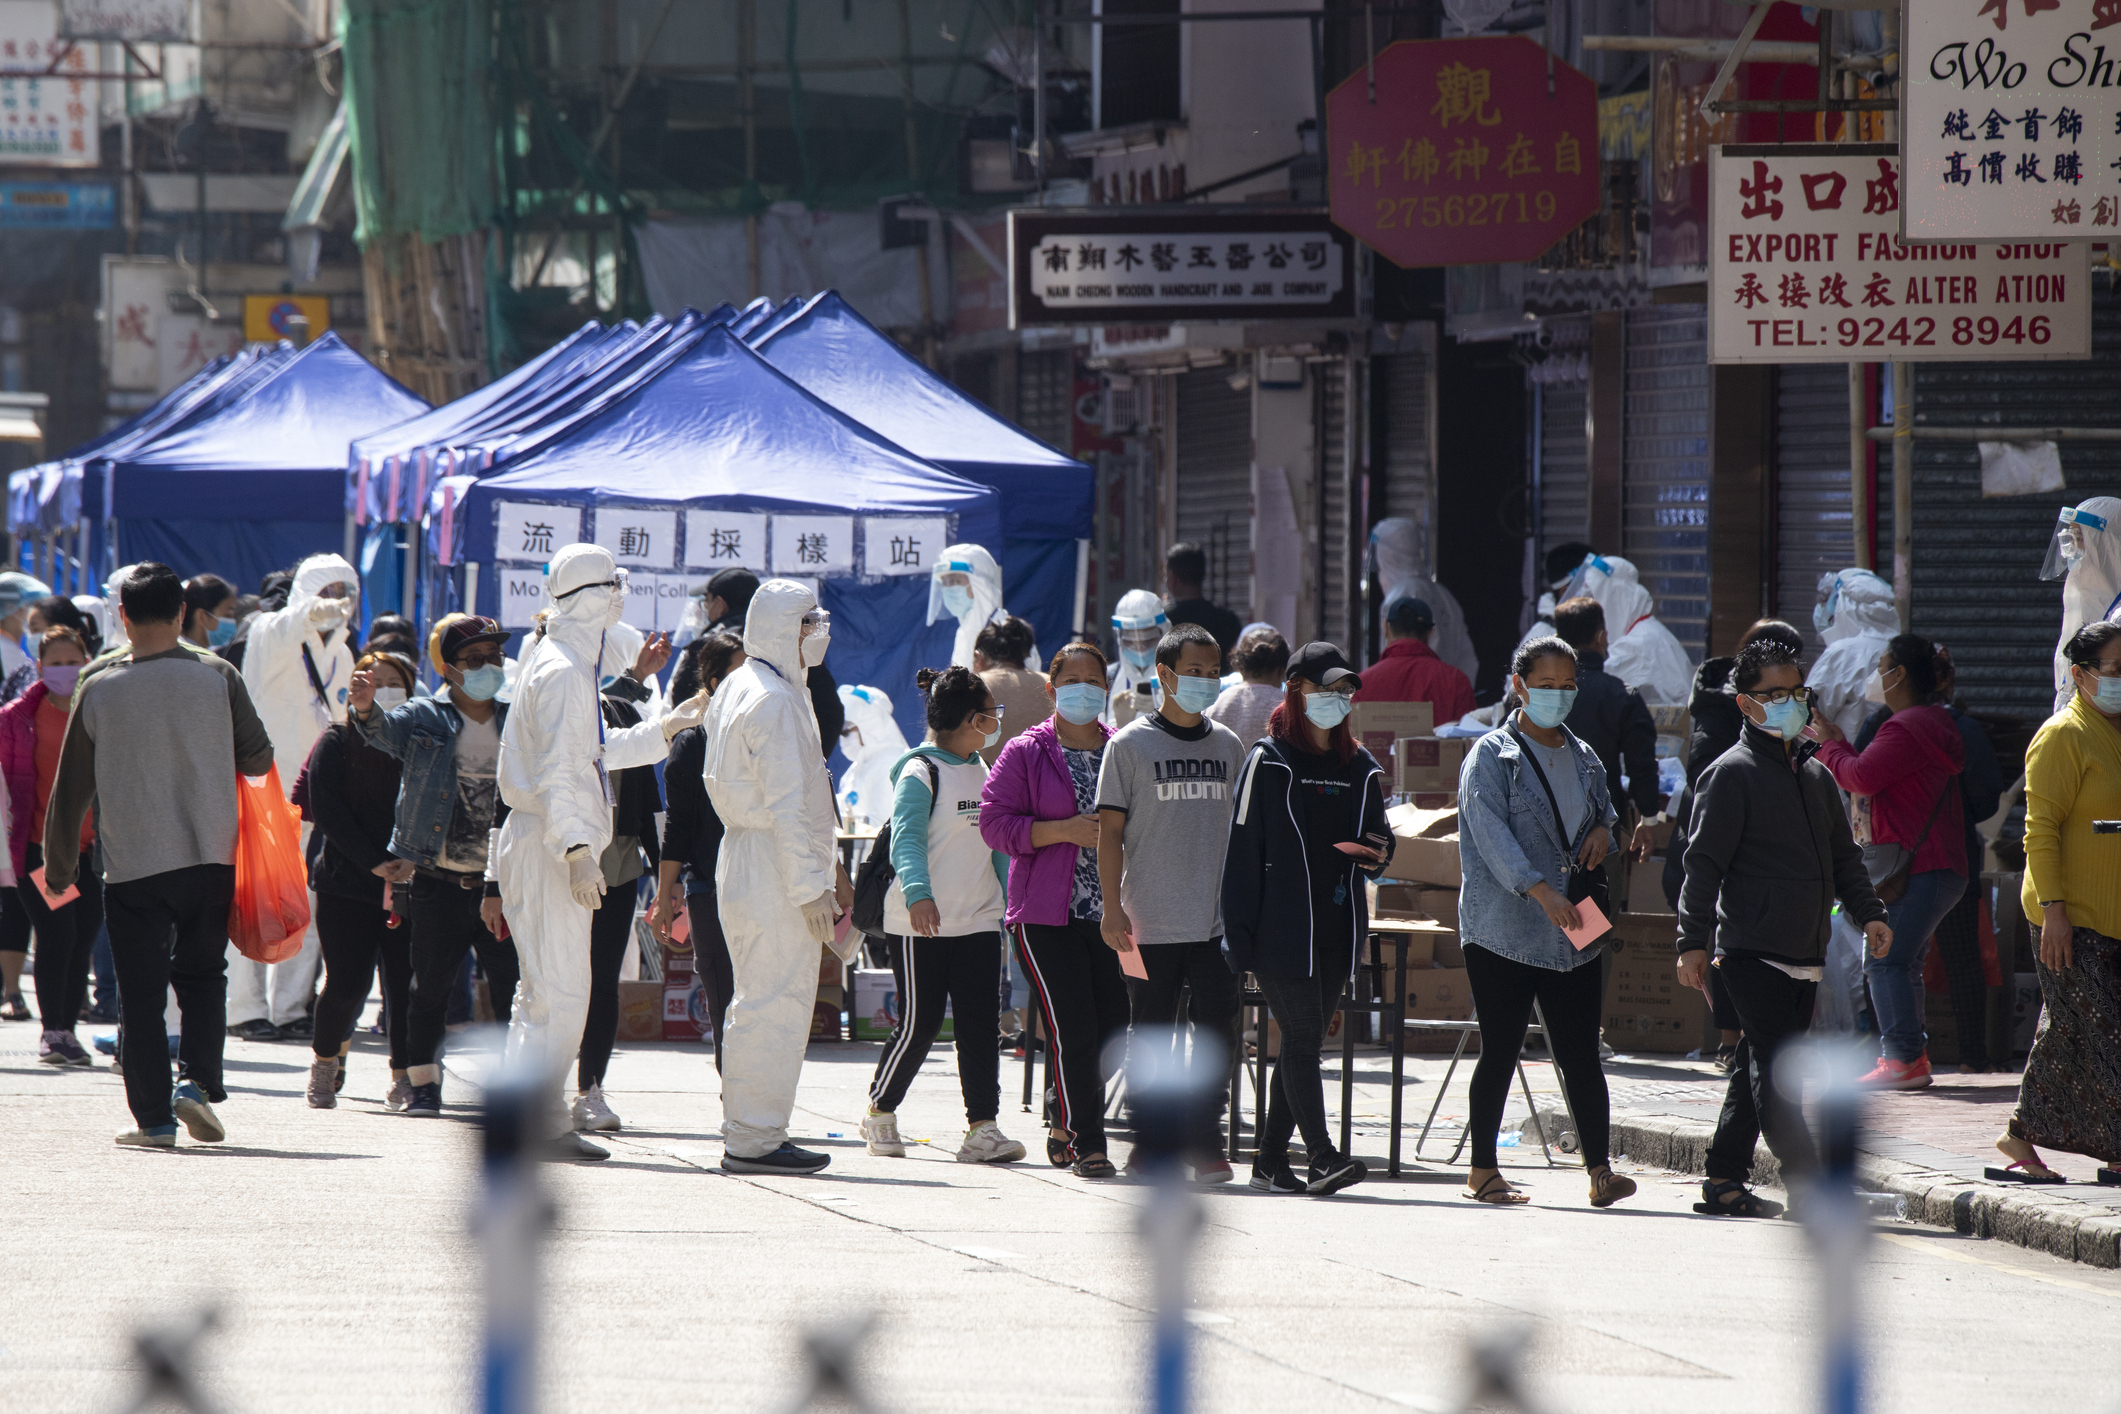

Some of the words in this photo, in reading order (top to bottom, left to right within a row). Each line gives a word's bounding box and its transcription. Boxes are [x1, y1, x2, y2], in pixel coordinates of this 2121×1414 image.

[1930, 37, 2028, 90] Wo
[2047, 32, 2121, 88] Sh
[1430, 60, 1502, 128] 觀
[1941, 106, 2083, 145] 純金首飾
[1375, 189, 1557, 230] 27562719
[1729, 233, 1839, 263] EXPORT
[1857, 232, 1977, 262] FASHION
[1046, 284, 1070, 299] NAM
[1075, 284, 1112, 298] CHEONG
[1116, 284, 1154, 298] WOODEN
[1160, 283, 1218, 297] HANDICRAFT
[1222, 283, 1243, 297] AND
[1251, 282, 1274, 296] JADE
[1283, 281, 1327, 296] COMPANY
[1734, 272, 1896, 311] 承接改衣
[1905, 276, 1978, 305] ALTER
[1996, 275, 2065, 304] ATION
[1747, 319, 1828, 347] TEL:
[1837, 317, 1936, 347] 9242
[1951, 315, 2052, 346] 8946
[522, 520, 920, 567] 流動採樣站
